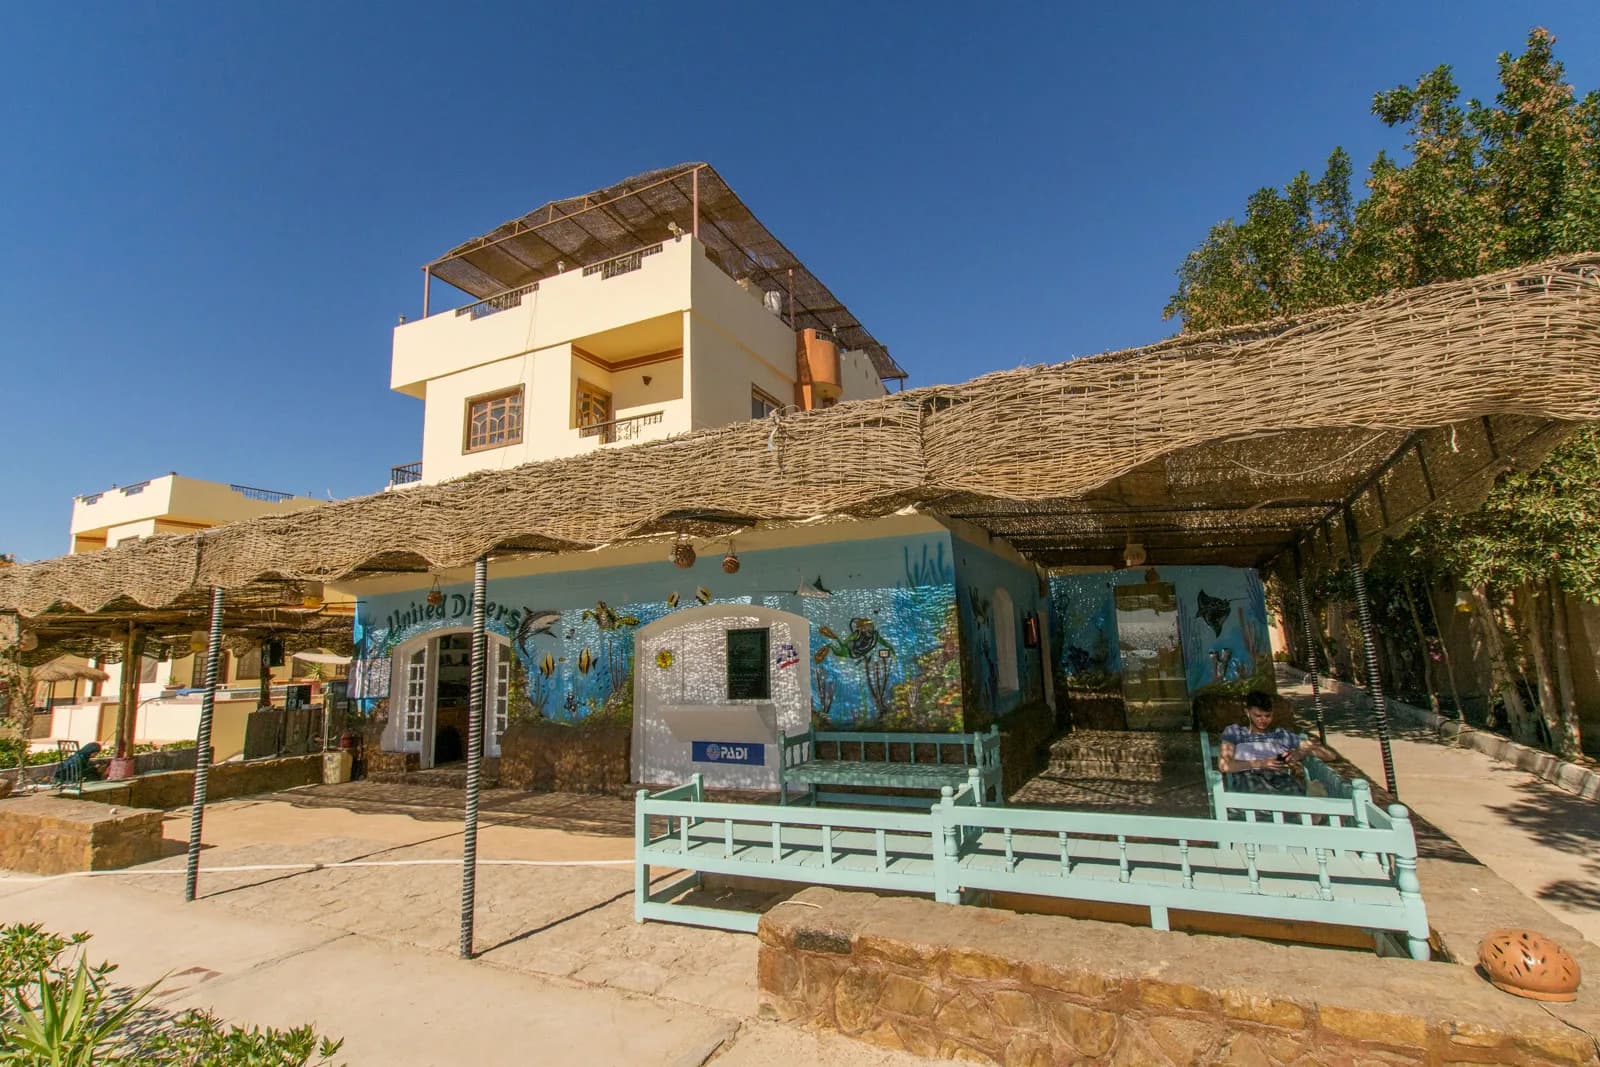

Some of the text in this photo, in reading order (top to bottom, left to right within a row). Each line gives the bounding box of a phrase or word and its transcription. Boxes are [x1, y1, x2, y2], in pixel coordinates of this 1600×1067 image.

[386, 593, 521, 635] United Diers
[720, 745, 748, 760] PADI
